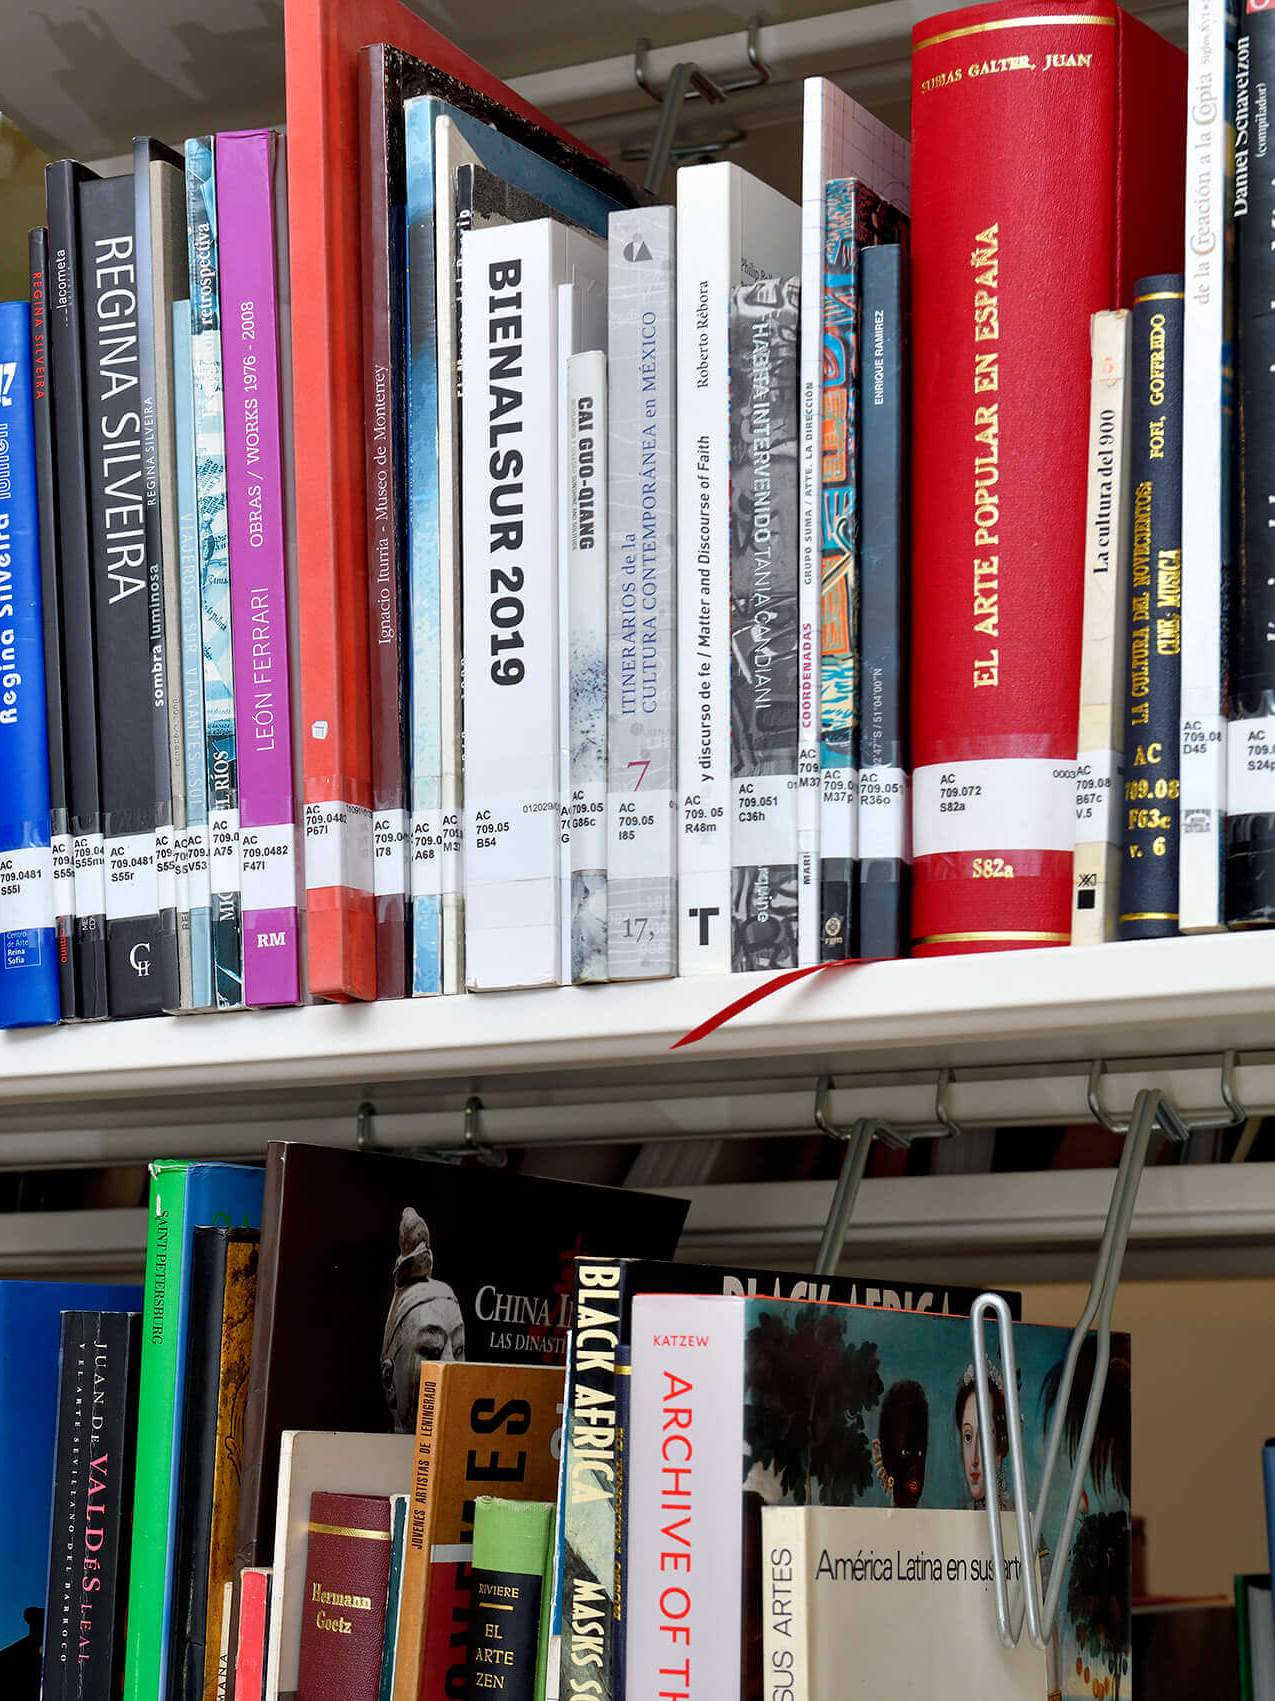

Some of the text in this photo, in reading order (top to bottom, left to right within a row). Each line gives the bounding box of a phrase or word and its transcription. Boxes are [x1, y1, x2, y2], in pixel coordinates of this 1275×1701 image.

[967, 55, 1037, 78] GALTER,
[1042, 53, 1093, 72] JUAN
[55, 248, 67, 311] lacometa
[198, 222, 217, 325] retrospectiva
[31, 271, 46, 400] REGINA SILVEIRA
[695, 279, 710, 389] Roberto Rébora
[874, 309, 885, 405] ENRIQUE RAMIREZ
[94, 235, 148, 606] REGINA SILVEIRA
[240, 300, 264, 548] OBRAS WORKS 1976 2008
[487, 257, 526, 687] BIENALSUR 2019
[969, 221, 1001, 689] EL ARTE POPULAR EN ESPAÑA
[373, 363, 393, 645] Ignacio Iturria Museo de Monterrey
[577, 396, 596, 552] CAI GUO-QIANG
[638, 310, 658, 715] CULTURA CONTEMPORÁNEA en MÉXICO
[1092, 408, 1116, 574] La cultura del 900
[696, 434, 715, 783] y discurso de fe Matter and Discourse of Faith
[752, 402, 773, 709] INTERVENIDO TANIA CANDIANI
[148, 563, 165, 707] sombra luminosa
[250, 587, 274, 751] LEÓN FERRARI
[620, 532, 636, 716] ITINERARIOS de la
[475, 809, 491, 822] AC
[475, 822, 510, 834] 709.05
[939, 785, 983, 799] 709.072
[940, 773, 957, 785] AC
[476, 836, 498, 849] B54
[256, 930, 287, 948] RM
[151, 1209, 170, 1346] SAINT PETERSBURG
[474, 1284, 550, 1328] CHINA
[651, 1334, 710, 1348] KATZEW
[77, 1340, 110, 1665] JUAN DE VALDÉS LEAL
[411, 1380, 438, 1550] JOVENES ARTISTAS DE LENINGRADO
[570, 1264, 621, 1669] BLACK AFRICA MASKS
[658, 1370, 694, 1648] ARCHIVE OF
[311, 1582, 372, 1611] Hermann
[478, 1583, 520, 1600] RIVIERE
[769, 1546, 794, 1639] ARTES
[814, 1547, 968, 1582] América Latina en
[316, 1610, 353, 1636] Goetz
[475, 1647, 515, 1666] ARTE
[484, 1623, 504, 1640] EL
[475, 1671, 506, 1690] ZEN
